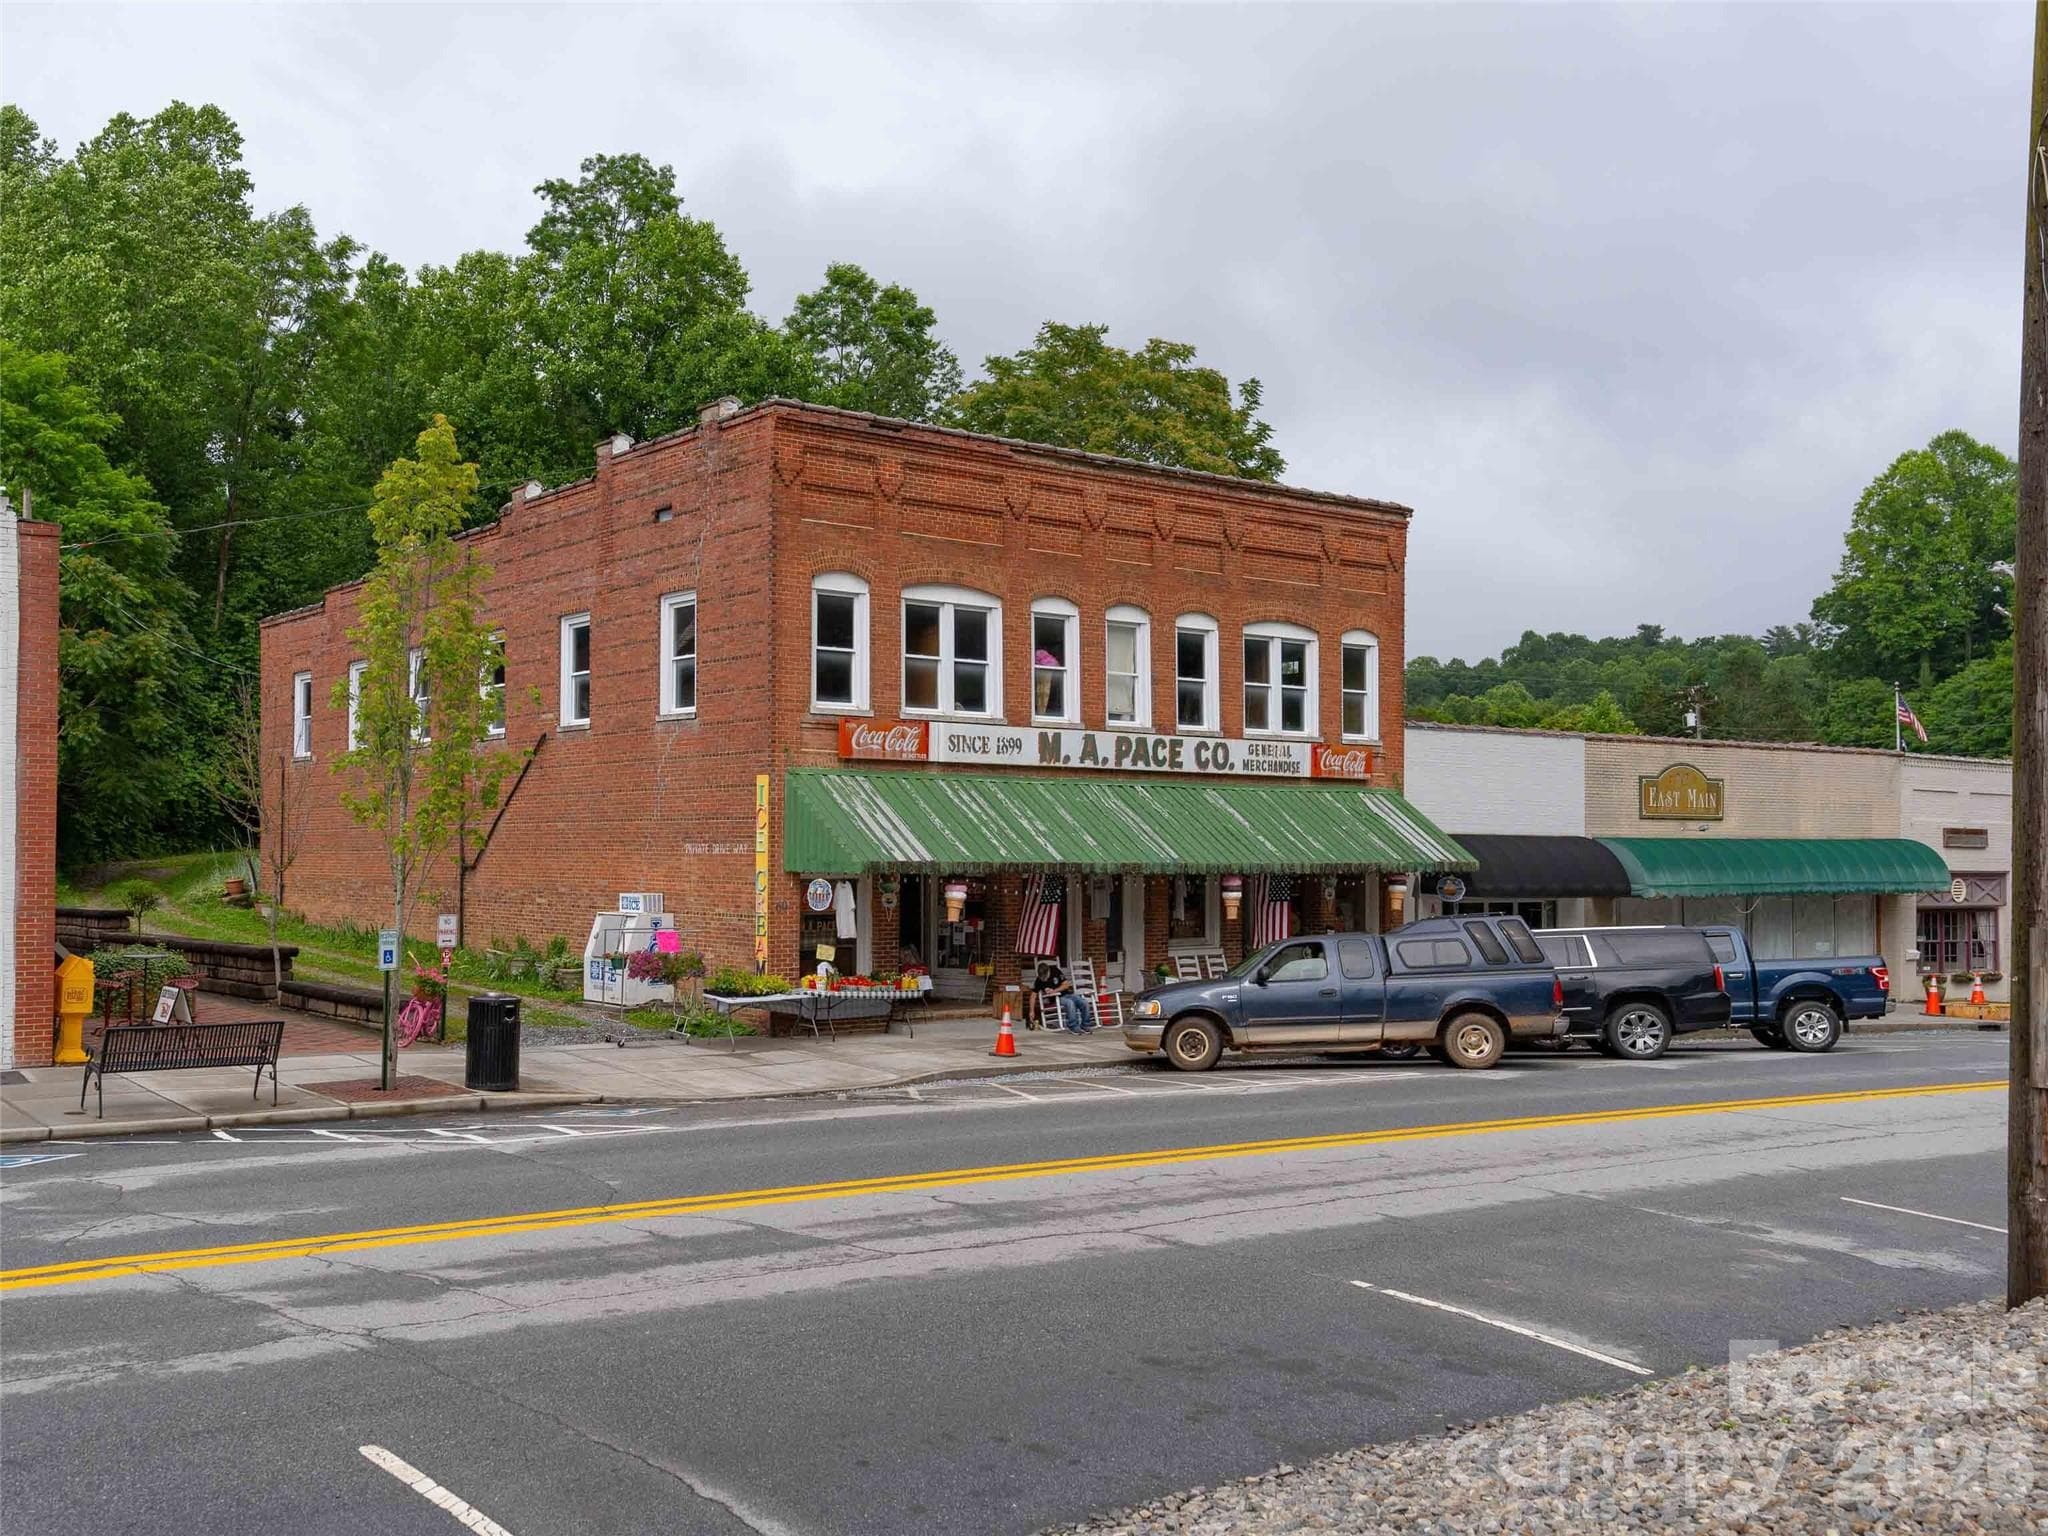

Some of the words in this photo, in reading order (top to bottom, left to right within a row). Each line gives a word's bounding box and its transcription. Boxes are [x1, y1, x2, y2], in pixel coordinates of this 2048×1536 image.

[948, 734, 991, 755] SINCE
[996, 736, 1023, 756] 1899
[1038, 731, 1071, 765] M.
[1079, 733, 1109, 766] A.
[1114, 735, 1183, 770] PACE
[1194, 740, 1235, 771] CO.
[1242, 759, 1301, 774] MERCHANDISE
[756, 784, 767, 853] ICE
